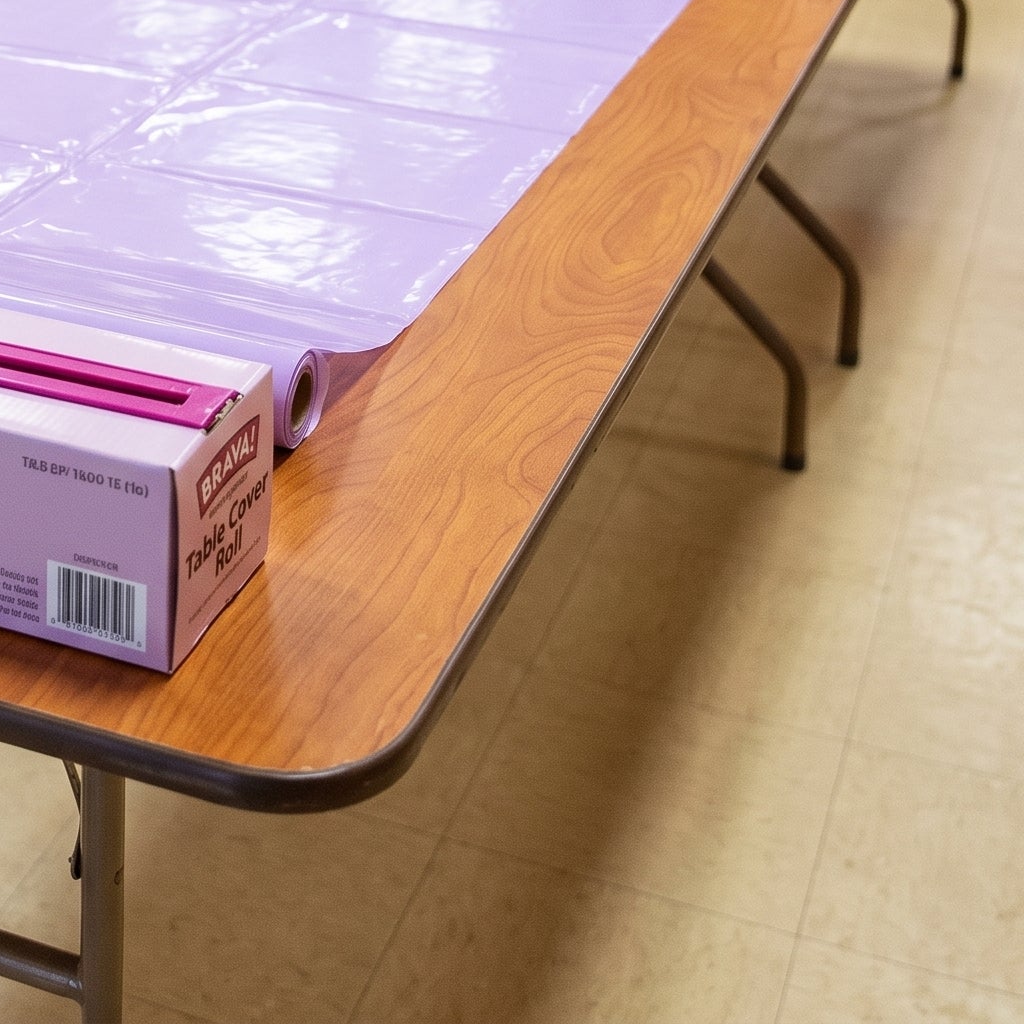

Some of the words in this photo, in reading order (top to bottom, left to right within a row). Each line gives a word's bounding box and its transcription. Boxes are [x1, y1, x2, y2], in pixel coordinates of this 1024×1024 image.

[200, 425, 256, 506] BRAVA!
[185, 522, 226, 580] Table
[228, 470, 269, 530] Cover
[215, 523, 243, 578] Roll
